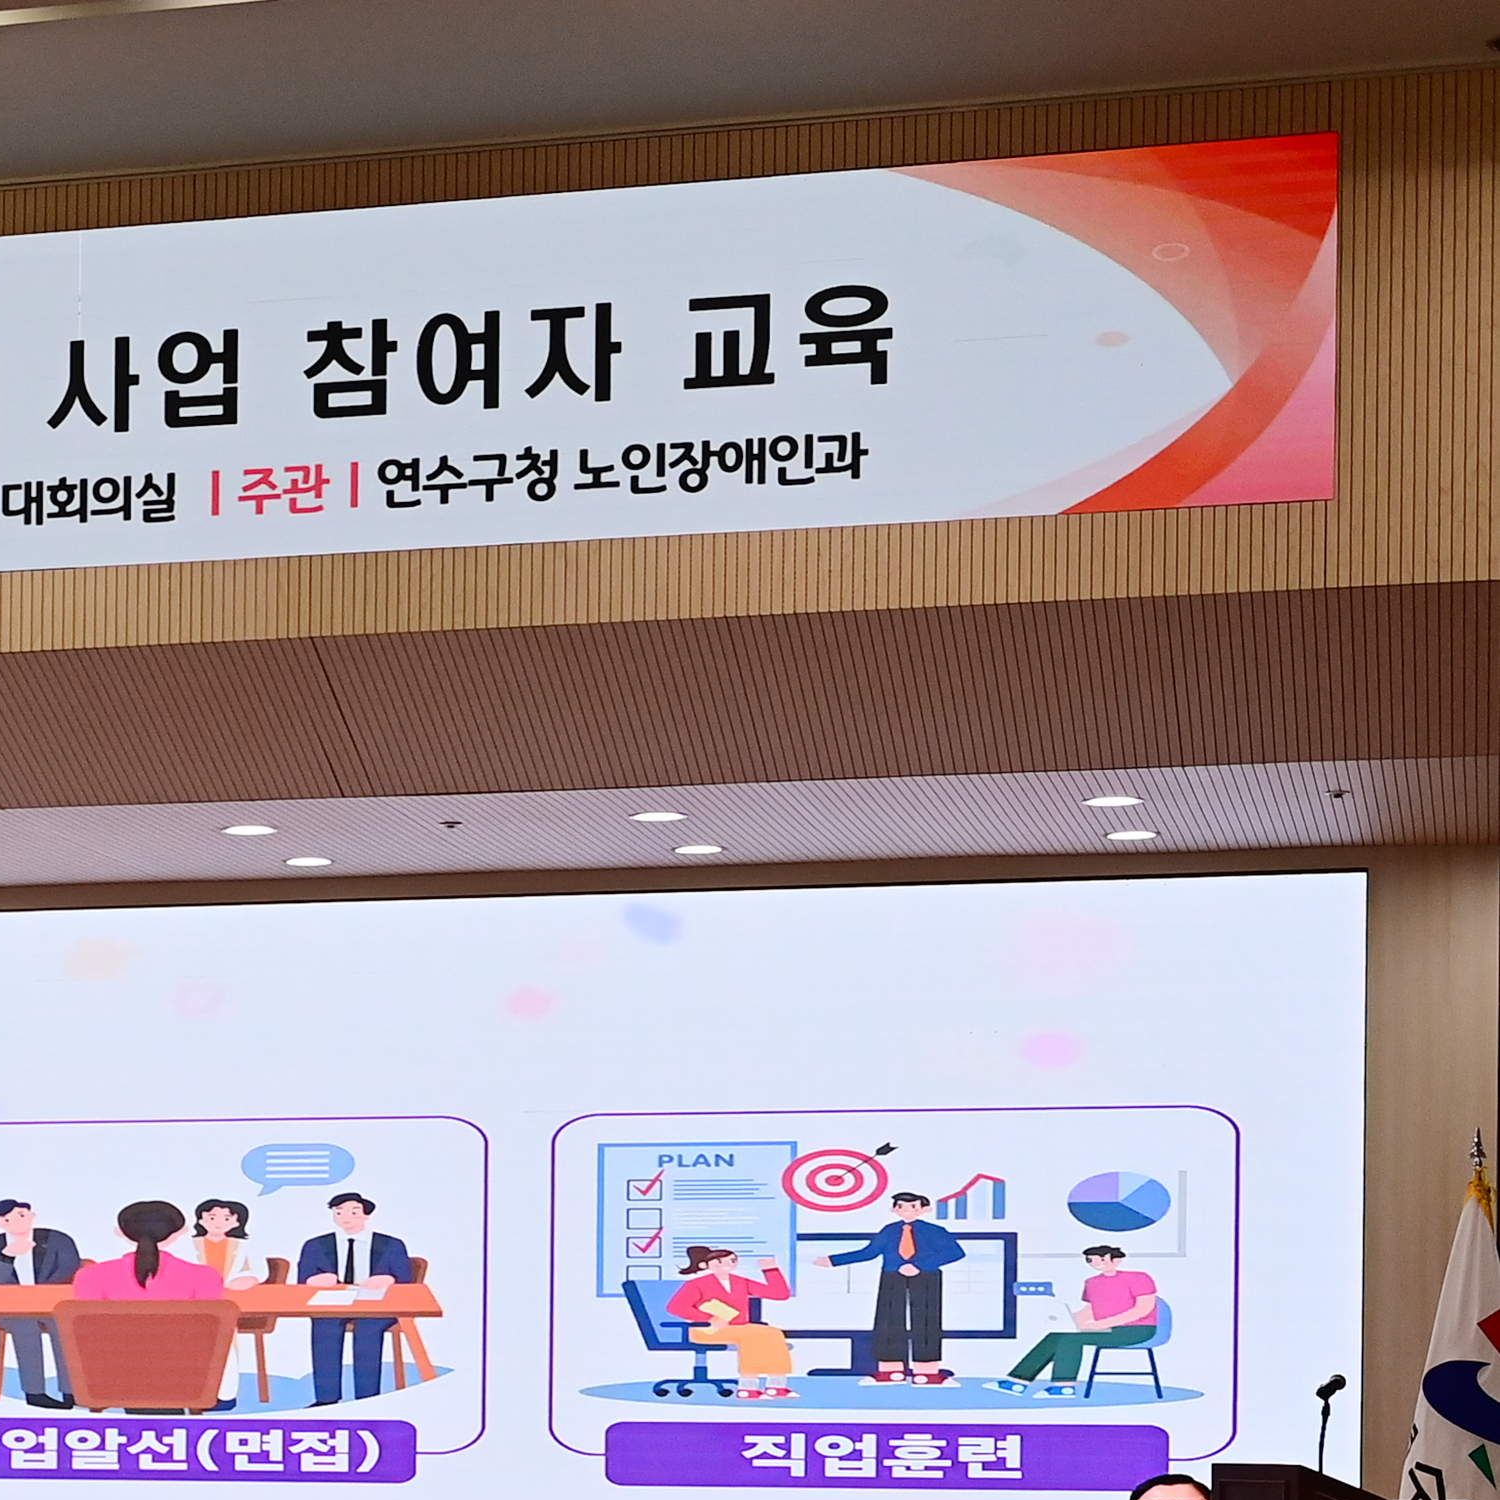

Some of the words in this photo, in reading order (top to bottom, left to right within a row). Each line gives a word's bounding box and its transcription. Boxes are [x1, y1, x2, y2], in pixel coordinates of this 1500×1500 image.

[46, 328, 239, 433] 사업
[303, 301, 622, 419] 참여자
[683, 284, 894, 390] 교육
[1, 472, 176, 526] 대회의실
[377, 445, 559, 509] 연수구청
[573, 431, 869, 495] 노인장애인과
[657, 1153, 735, 1169] PLAN
[741, 1433, 1023, 1479] 직업훈련
